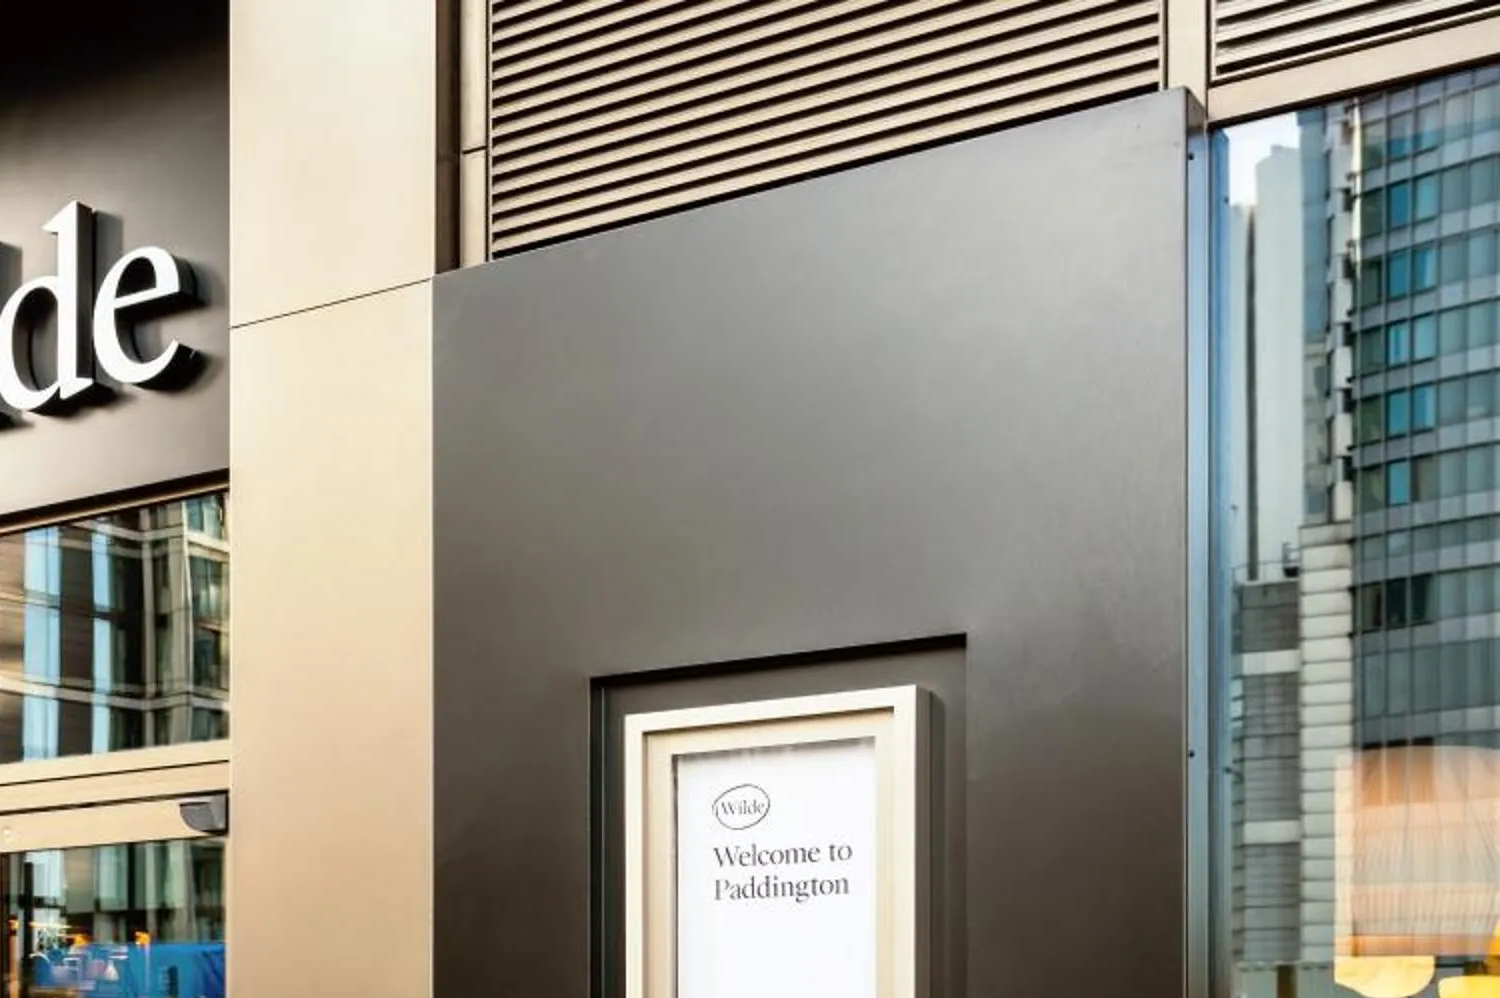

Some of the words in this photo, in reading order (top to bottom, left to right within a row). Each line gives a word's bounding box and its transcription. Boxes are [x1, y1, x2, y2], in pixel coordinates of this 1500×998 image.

[721, 799, 765, 816] Wilde
[713, 843, 821, 867] Welcome
[828, 843, 853, 862] to
[714, 875, 850, 903] Paddington
